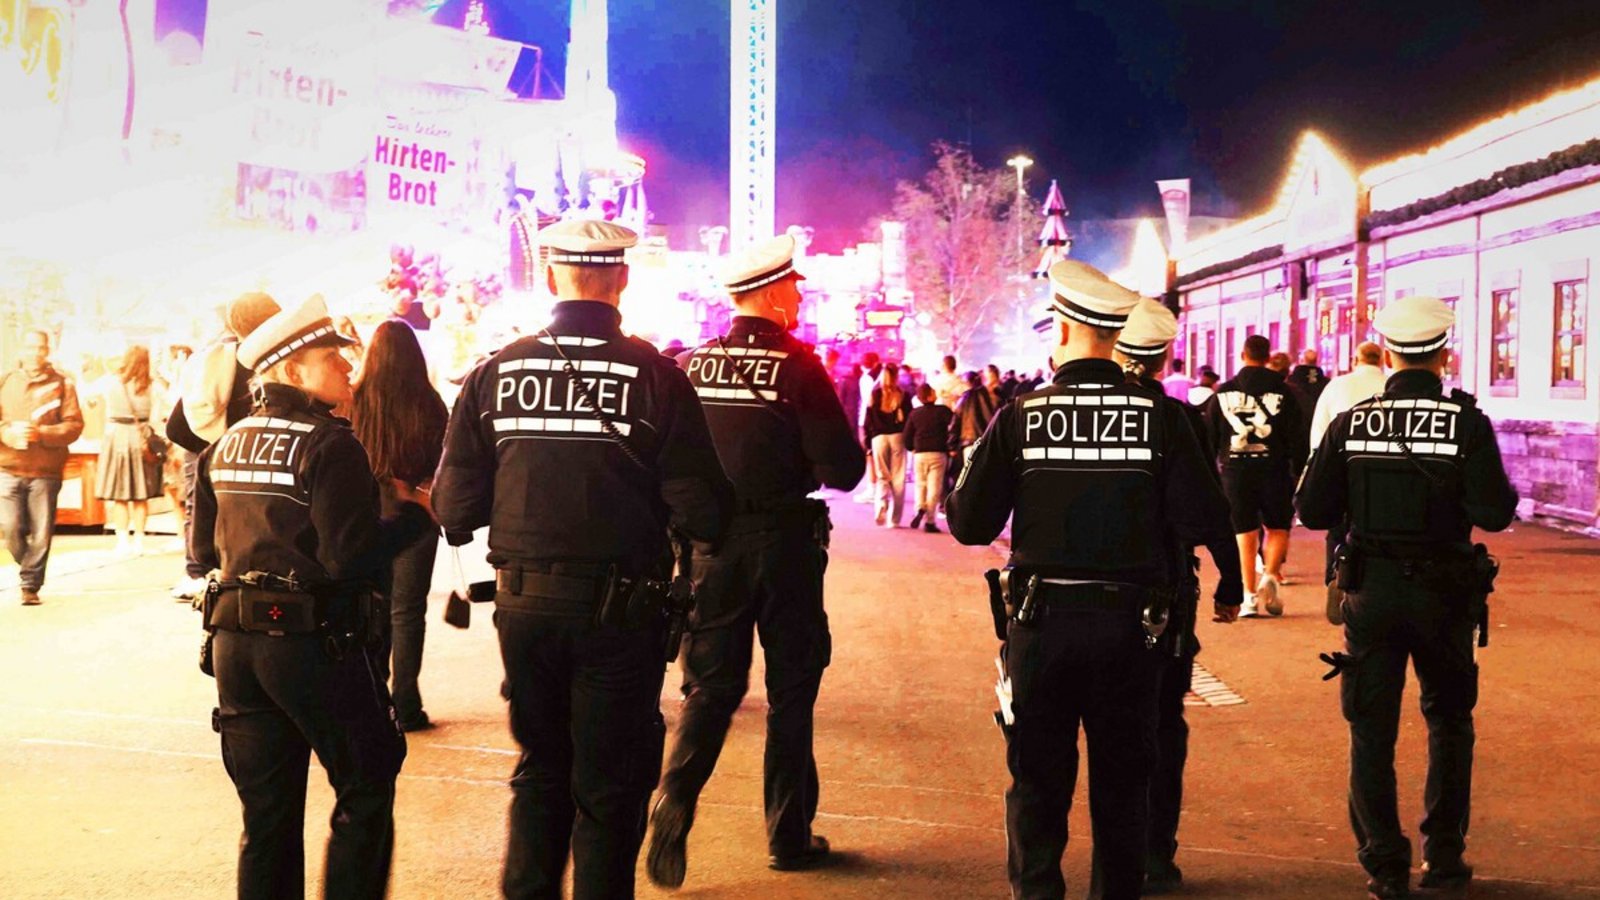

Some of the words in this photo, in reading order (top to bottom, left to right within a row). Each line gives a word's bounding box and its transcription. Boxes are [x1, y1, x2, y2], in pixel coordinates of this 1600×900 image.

[375, 135, 456, 174] Hirten-
[388, 172, 437, 207] Brot
[687, 357, 780, 386] POLIZEI
[496, 375, 630, 415] POLIZEI
[1026, 409, 1149, 442] POLIZEI
[1349, 409, 1457, 440] POLIZEI
[212, 432, 301, 467] POLIZEI
